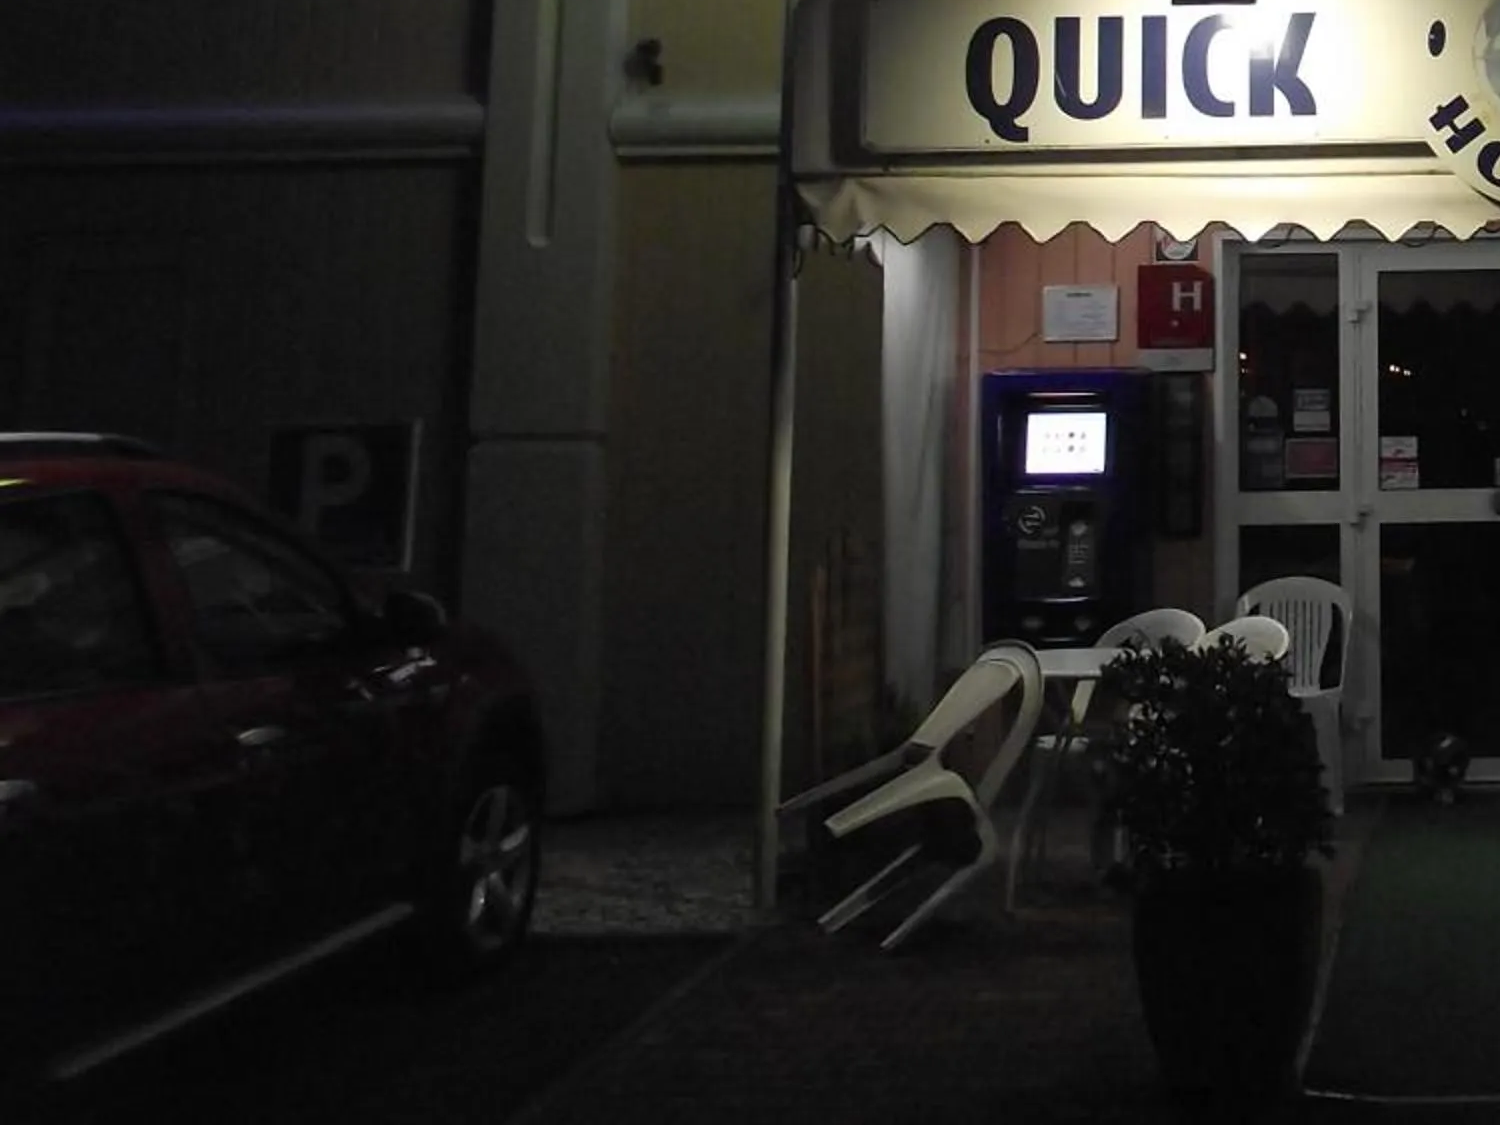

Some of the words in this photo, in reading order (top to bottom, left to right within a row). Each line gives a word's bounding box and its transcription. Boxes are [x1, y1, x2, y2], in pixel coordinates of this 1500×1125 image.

[964, 11, 1318, 143] QUICK
[1171, 281, 1203, 312] H
[299, 433, 372, 536] P
